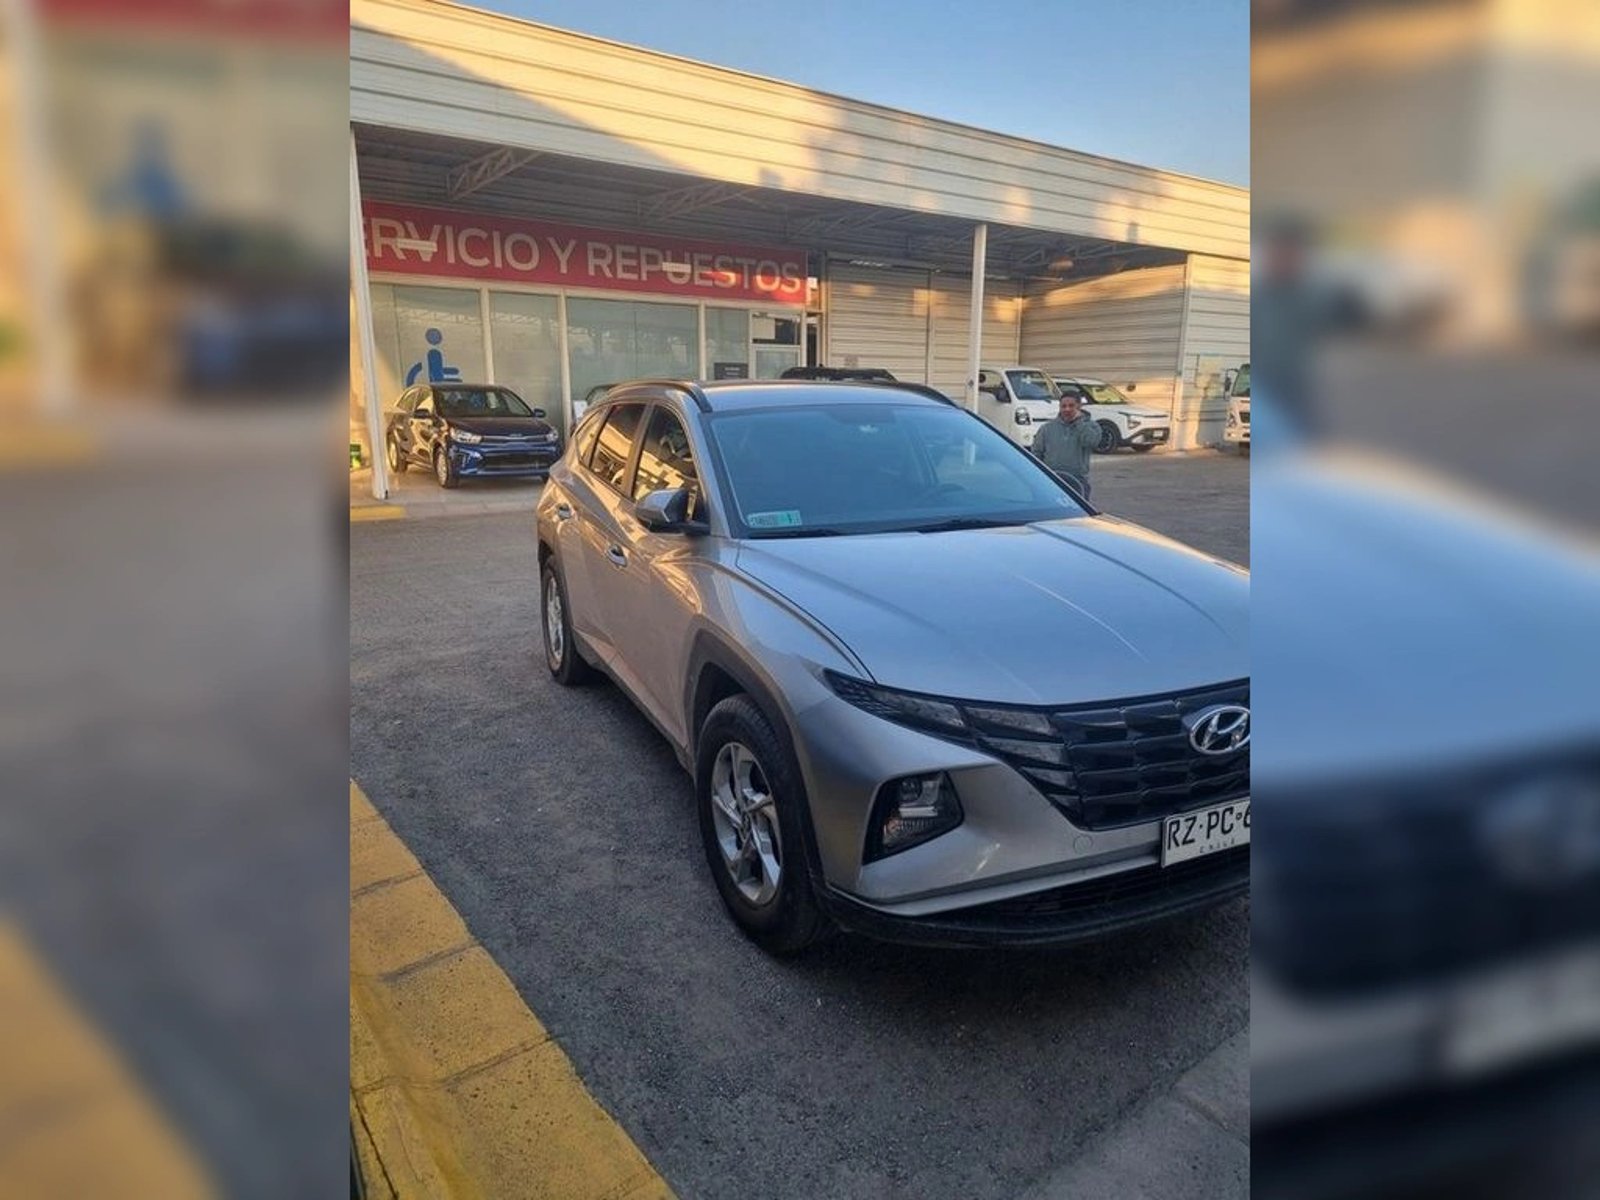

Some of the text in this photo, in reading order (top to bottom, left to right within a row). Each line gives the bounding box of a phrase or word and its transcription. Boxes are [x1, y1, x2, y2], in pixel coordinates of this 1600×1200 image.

[364, 218, 800, 293] RVICIO Y REPUESTOS
